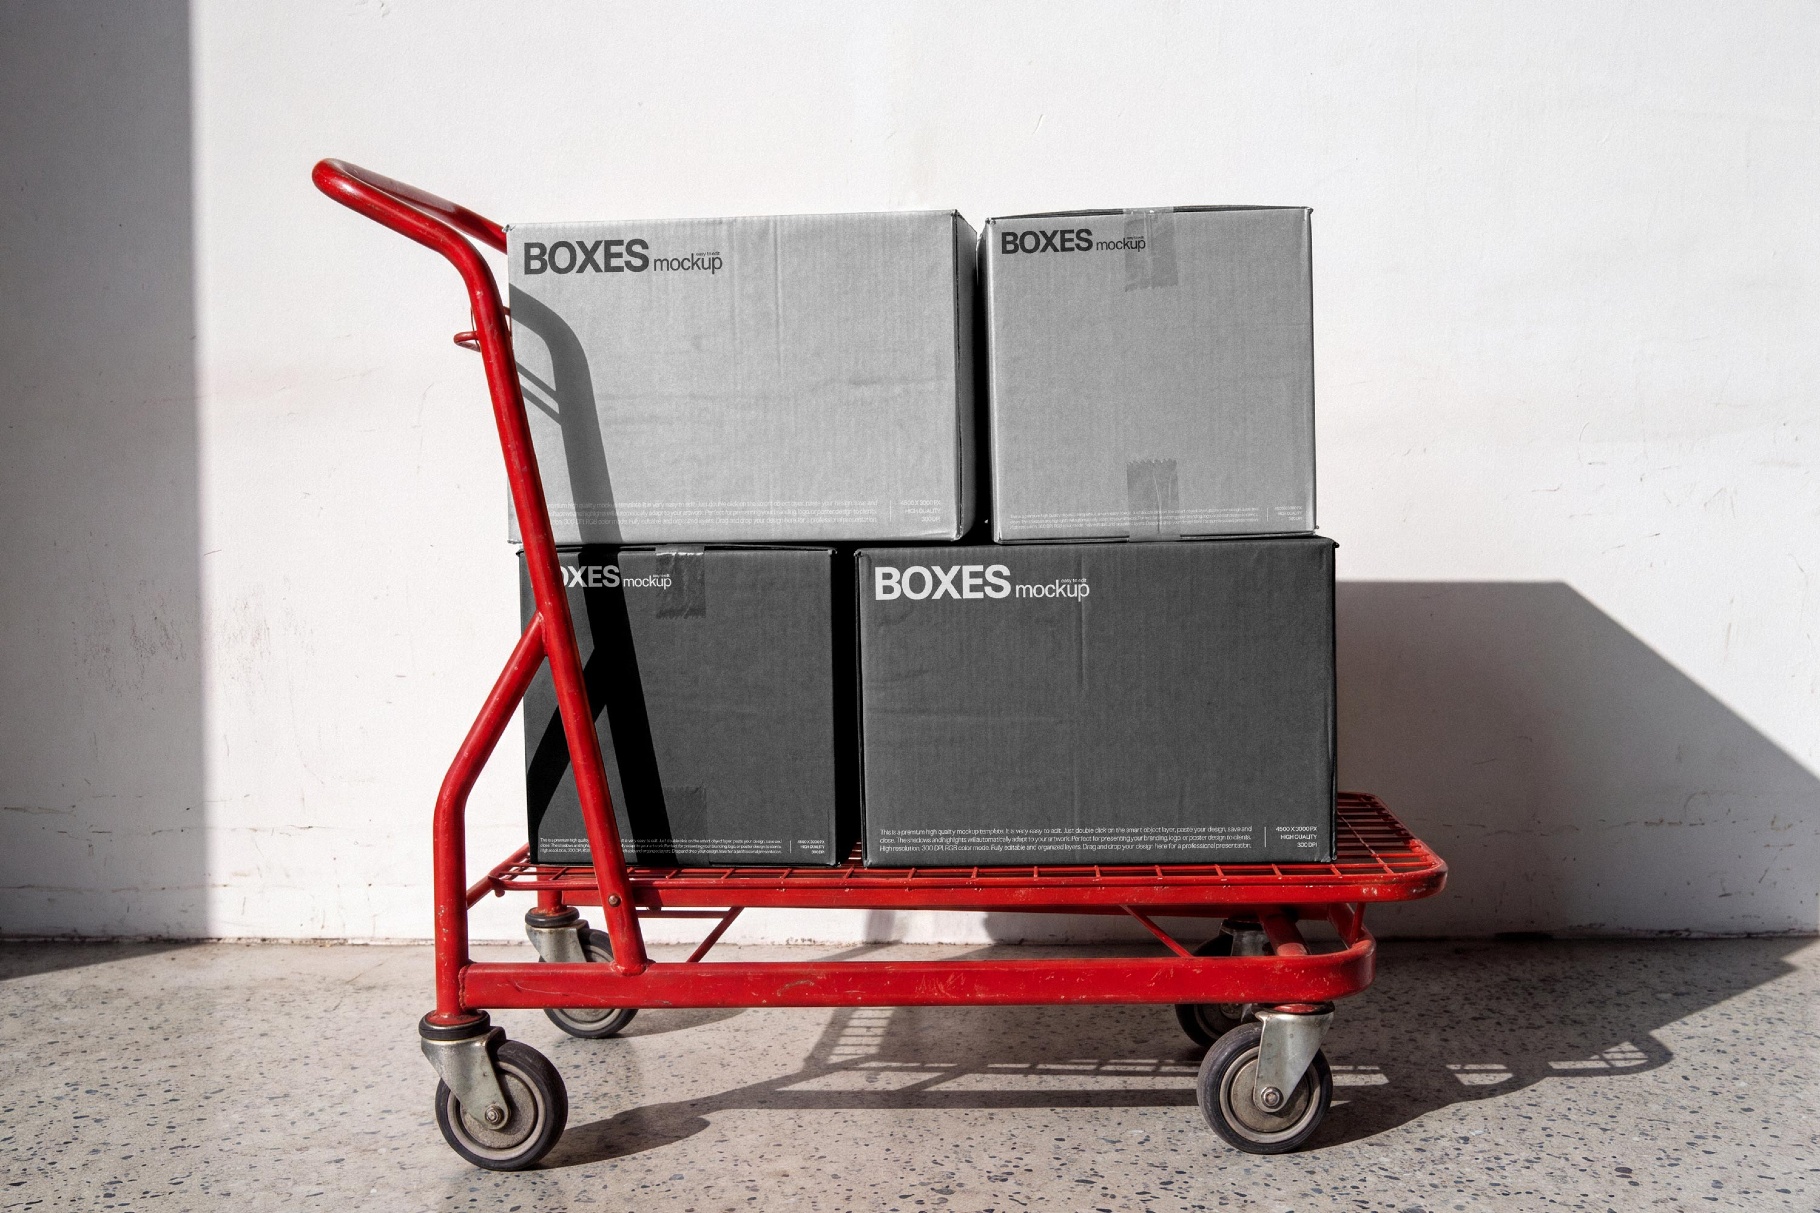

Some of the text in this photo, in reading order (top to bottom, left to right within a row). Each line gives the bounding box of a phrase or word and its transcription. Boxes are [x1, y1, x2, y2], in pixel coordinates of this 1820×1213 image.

[524, 238, 723, 275] BOXES mockup
[1001, 229, 1146, 254] BOXES mockup
[560, 565, 672, 590] XES mockup
[875, 565, 1090, 602] BOXES mockup
